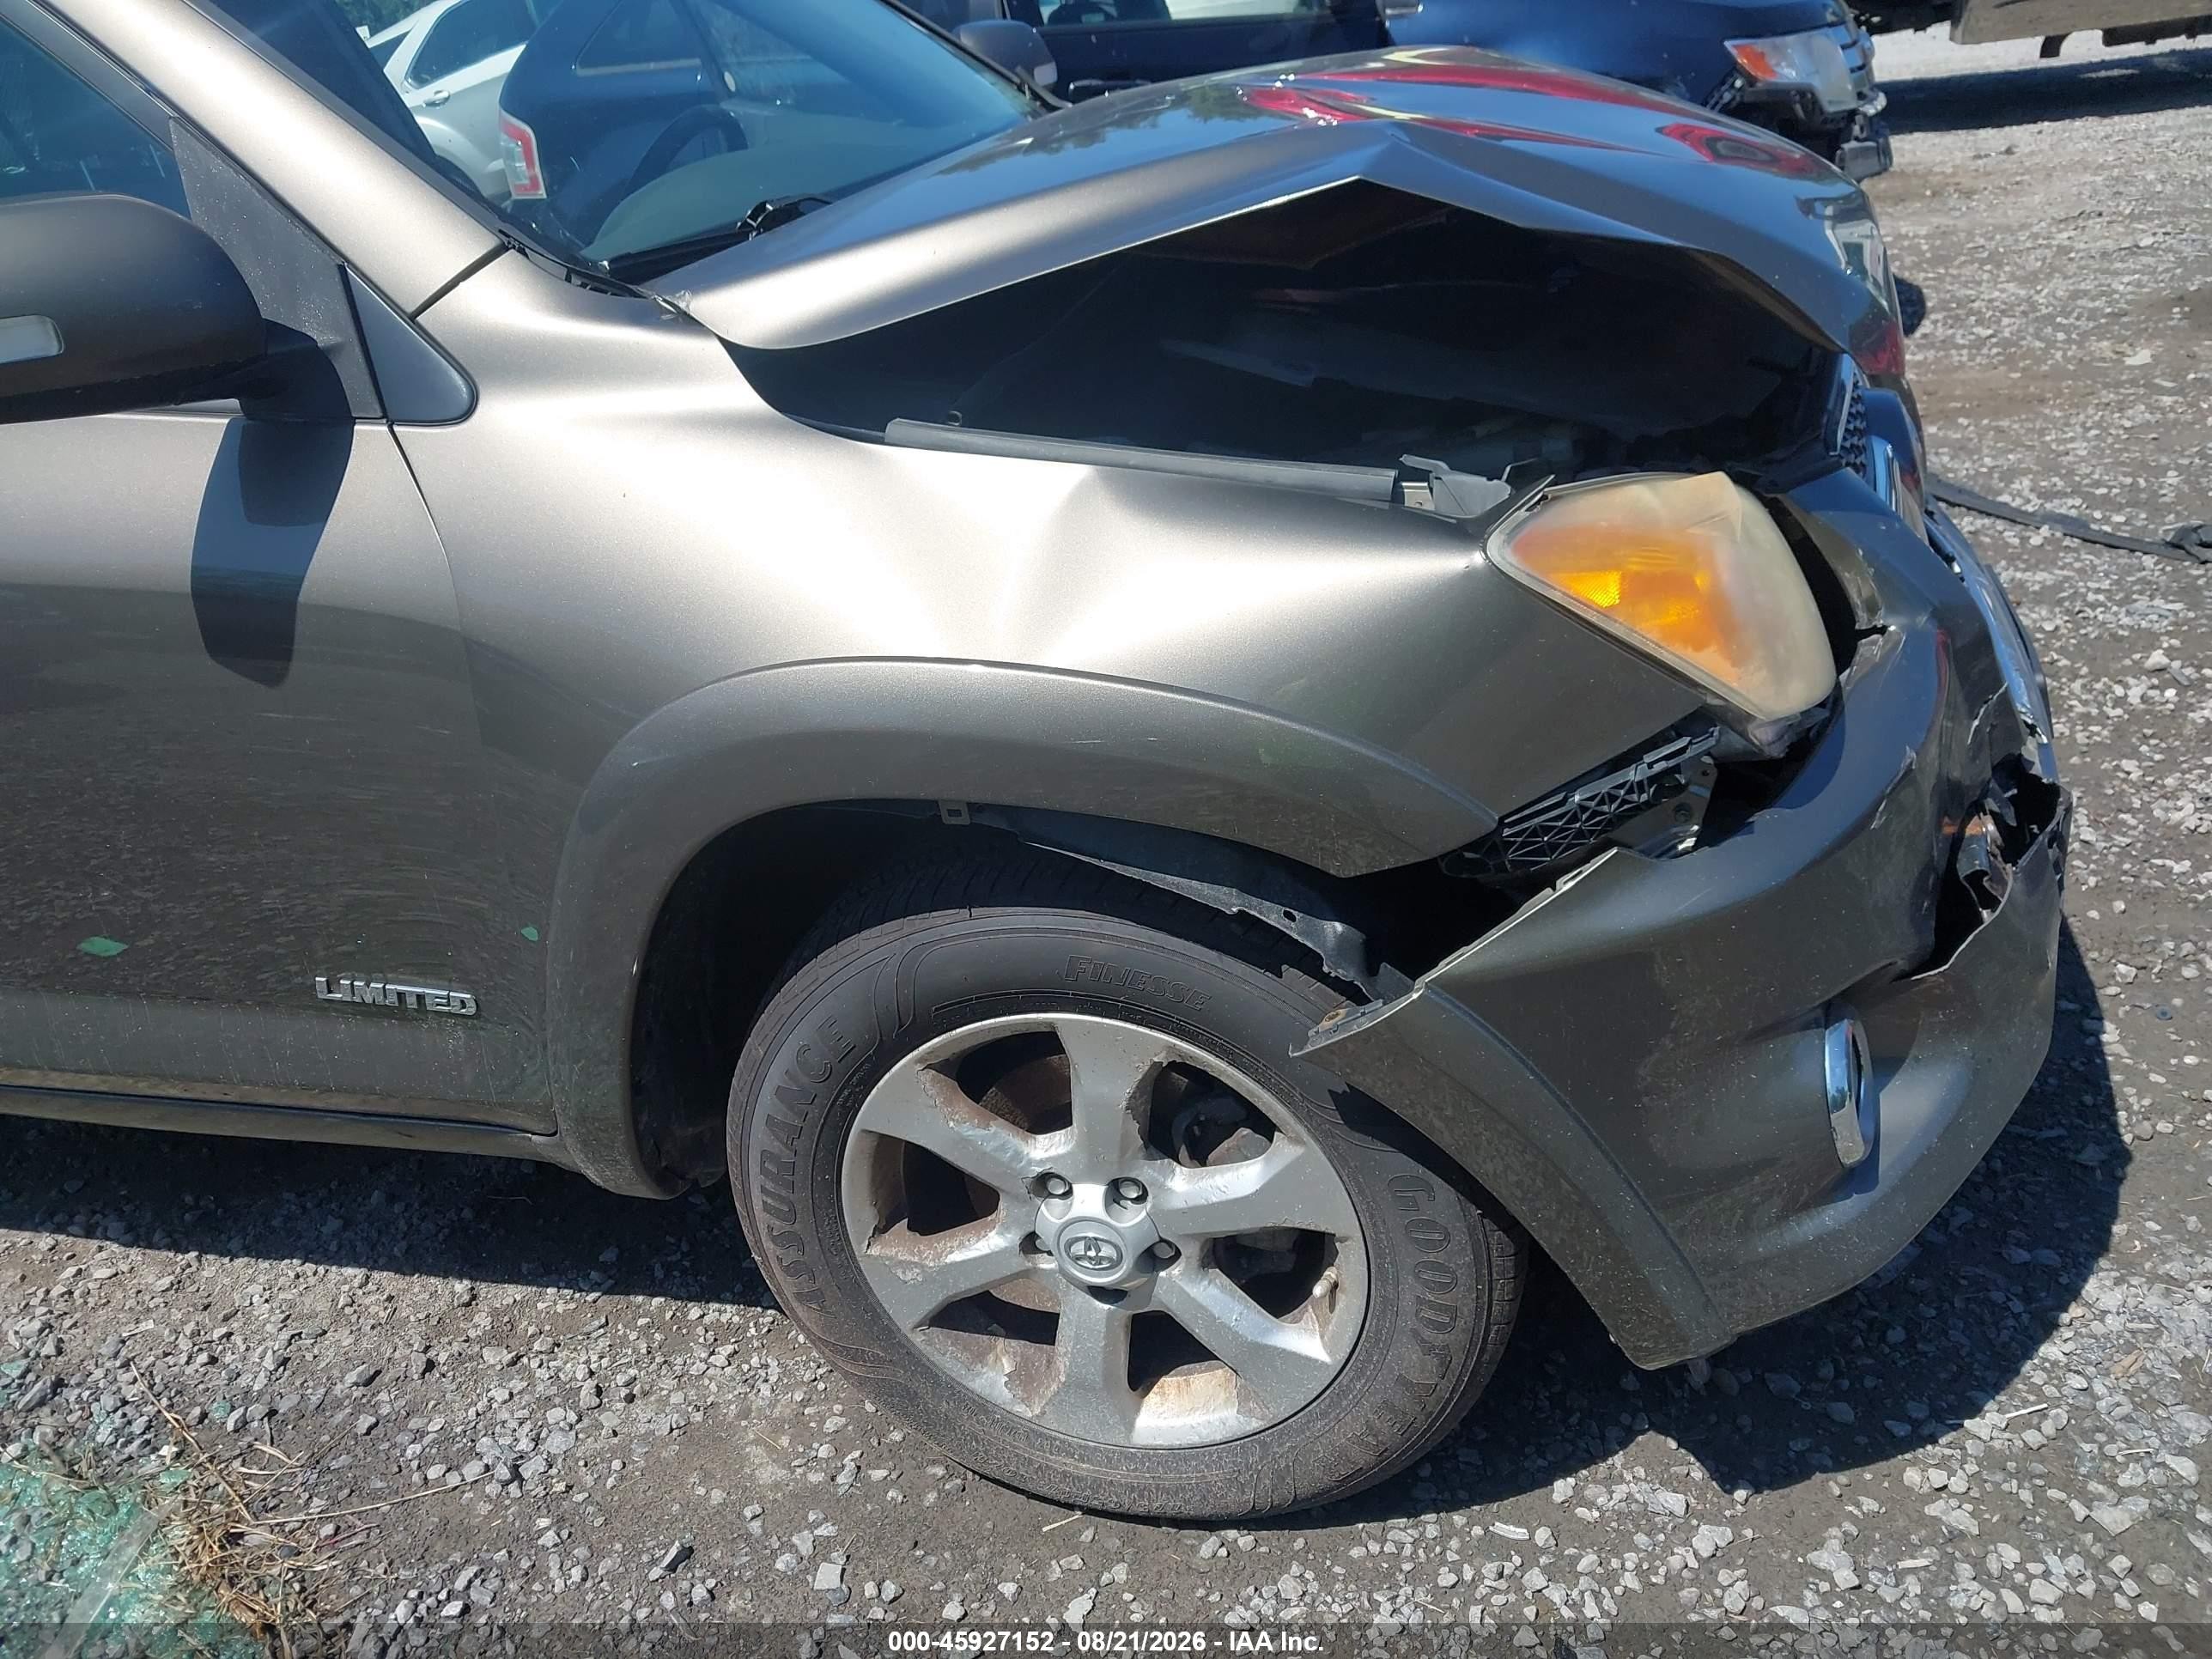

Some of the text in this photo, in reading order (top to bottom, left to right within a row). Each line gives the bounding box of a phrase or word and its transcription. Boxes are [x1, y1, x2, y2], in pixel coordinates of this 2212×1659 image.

[315, 977, 478, 1016] LIMITED
[1064, 954, 1212, 1011] FINESSE
[760, 1014, 857, 1319] ASSURANCE
